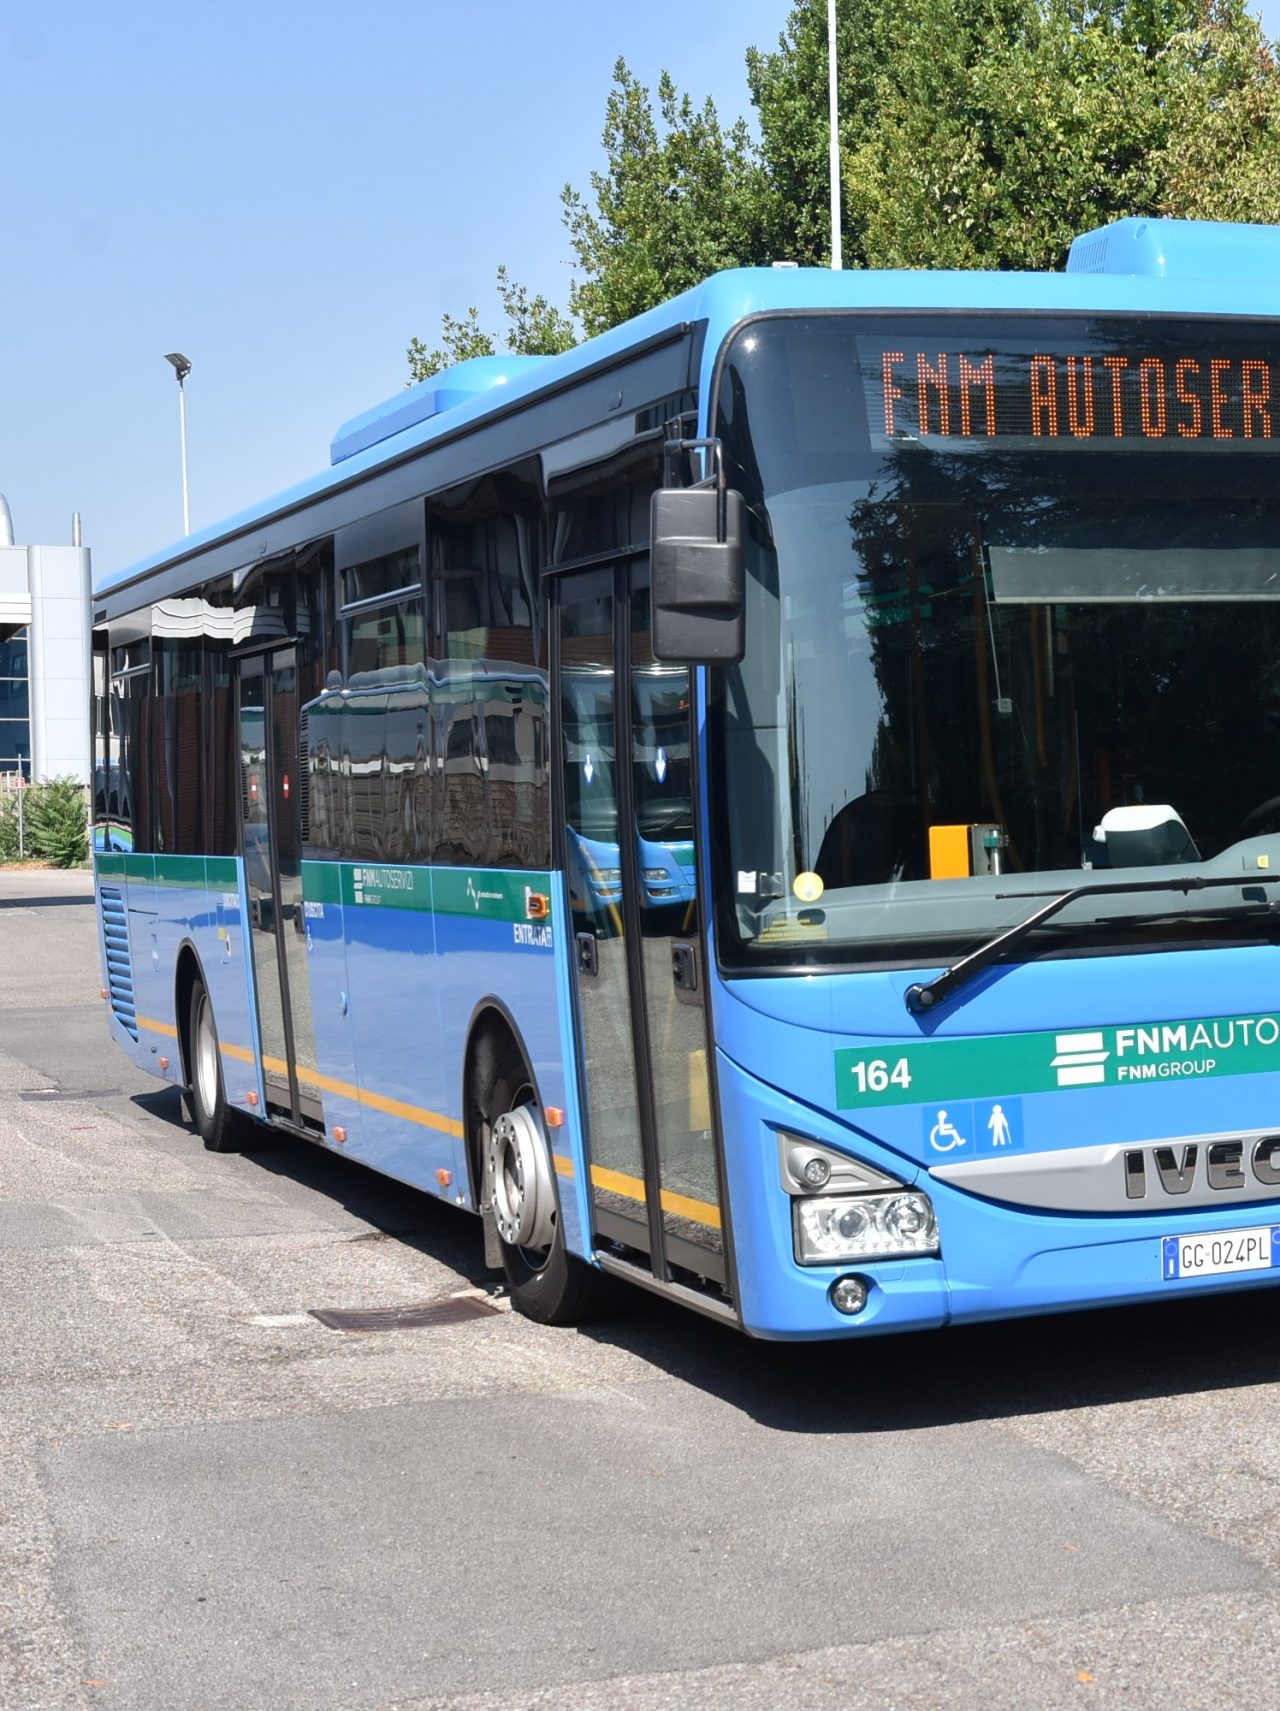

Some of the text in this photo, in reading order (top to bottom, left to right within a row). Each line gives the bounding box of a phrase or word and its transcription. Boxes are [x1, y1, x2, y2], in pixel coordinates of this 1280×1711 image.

[881, 352, 996, 437] FNM
[851, 1058, 912, 1093] 164
[1118, 1059, 1216, 1081] FNMGROUP
